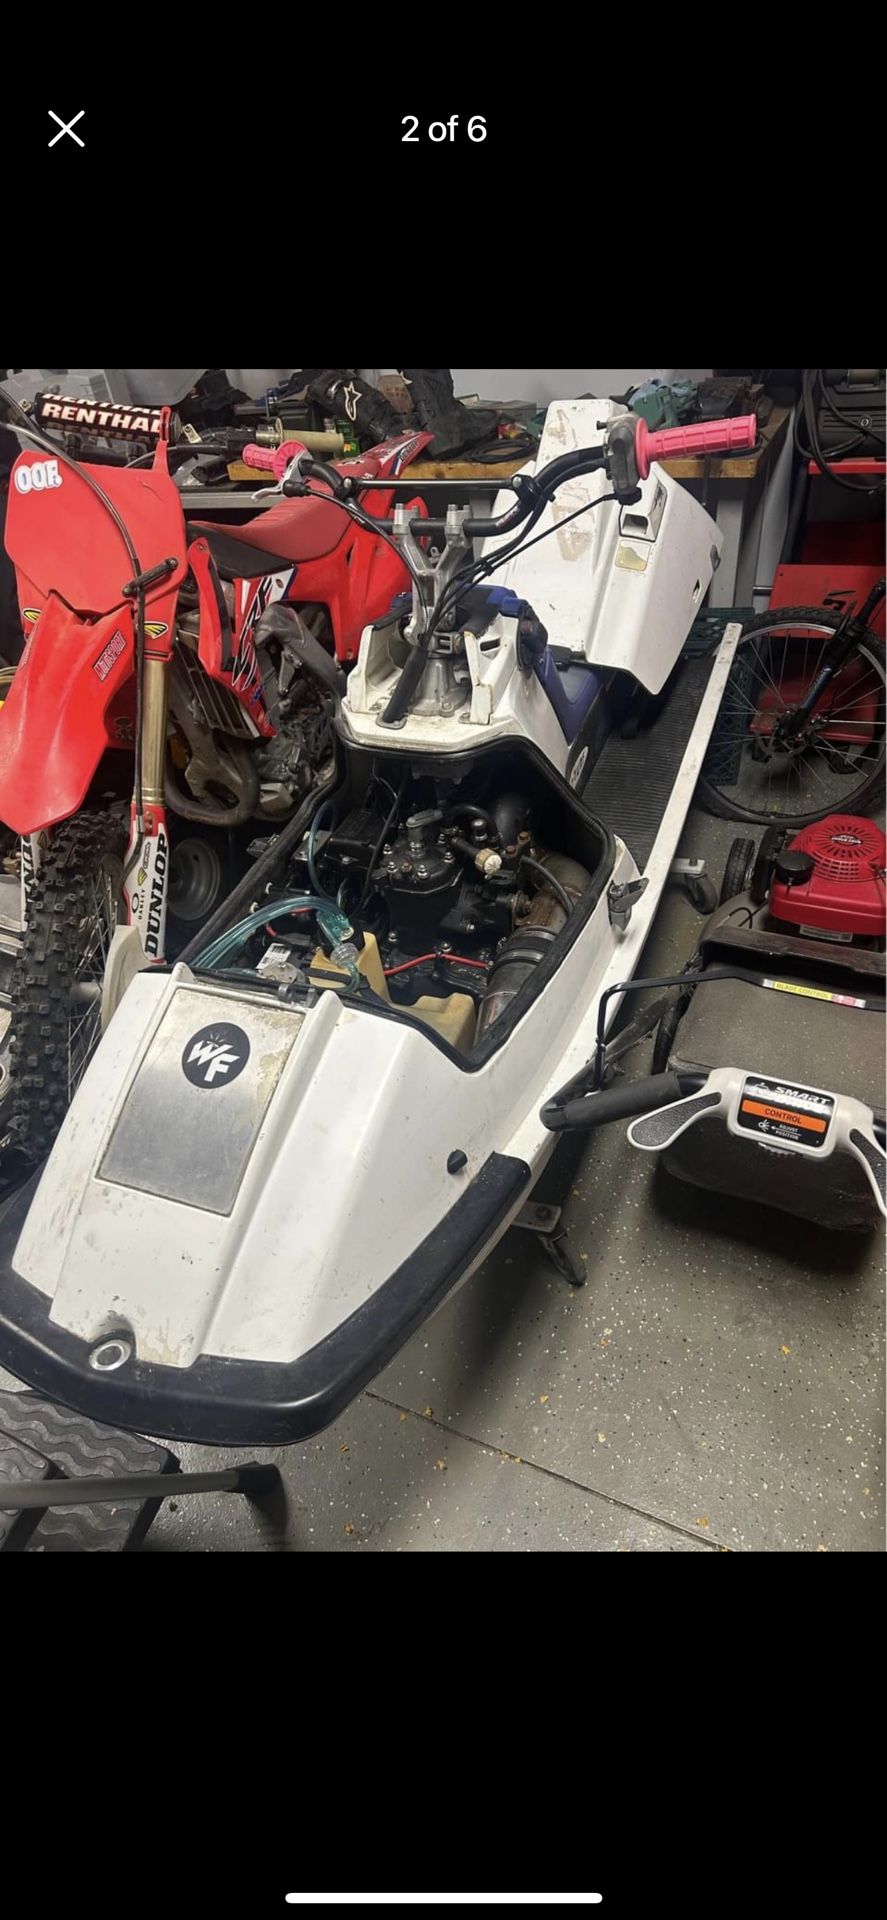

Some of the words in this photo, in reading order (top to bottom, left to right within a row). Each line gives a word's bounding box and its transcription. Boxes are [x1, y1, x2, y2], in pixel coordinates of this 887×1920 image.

[41, 402, 161, 433] RENTHAL
[145, 833, 167, 957] DUNLOP
[187, 1040, 240, 1083] WF
[774, 1086, 831, 1106] SMART
[764, 1107, 802, 1125] CONTROL
